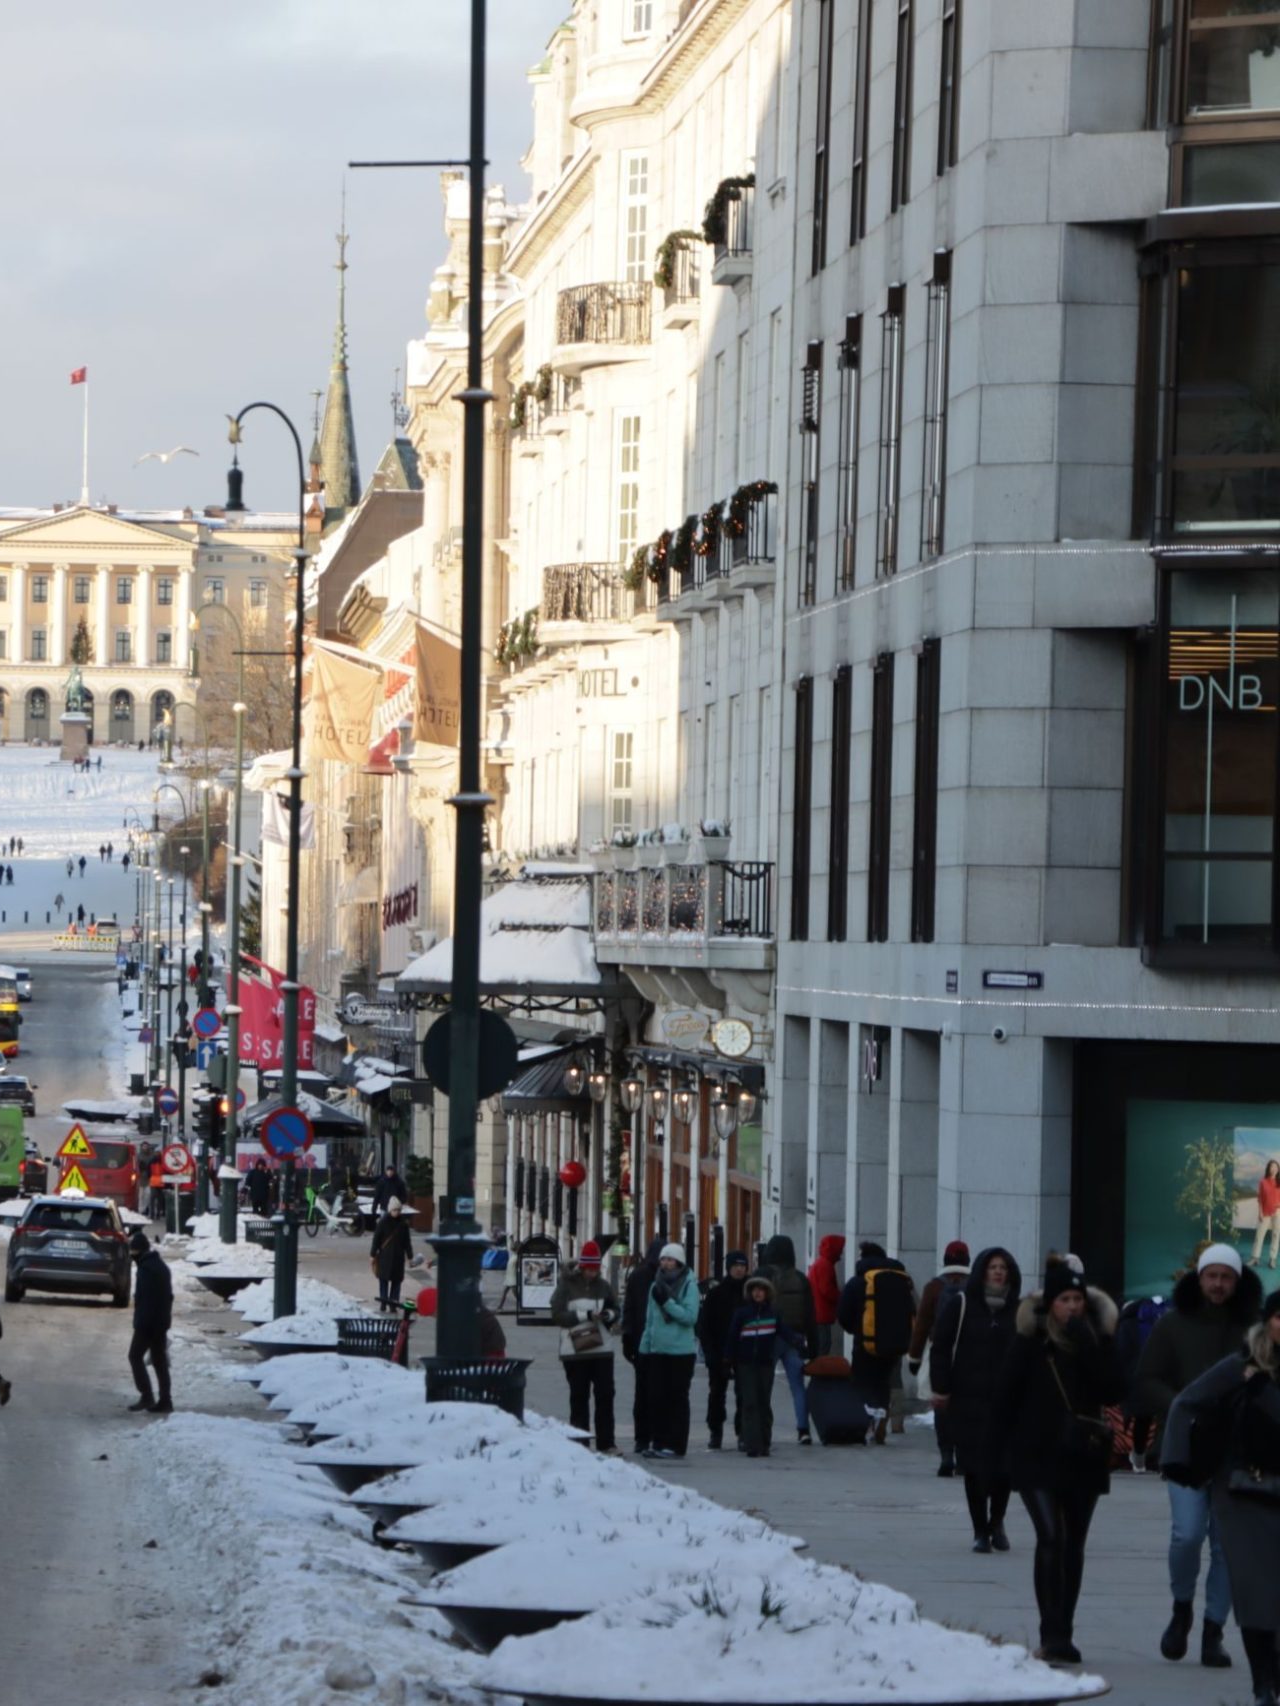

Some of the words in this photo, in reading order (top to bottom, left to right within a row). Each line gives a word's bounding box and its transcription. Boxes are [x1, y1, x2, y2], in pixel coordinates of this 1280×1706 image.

[577, 667, 628, 698] HOTEL
[1180, 674, 1263, 710] DNB
[313, 726, 366, 746] HOTEL
